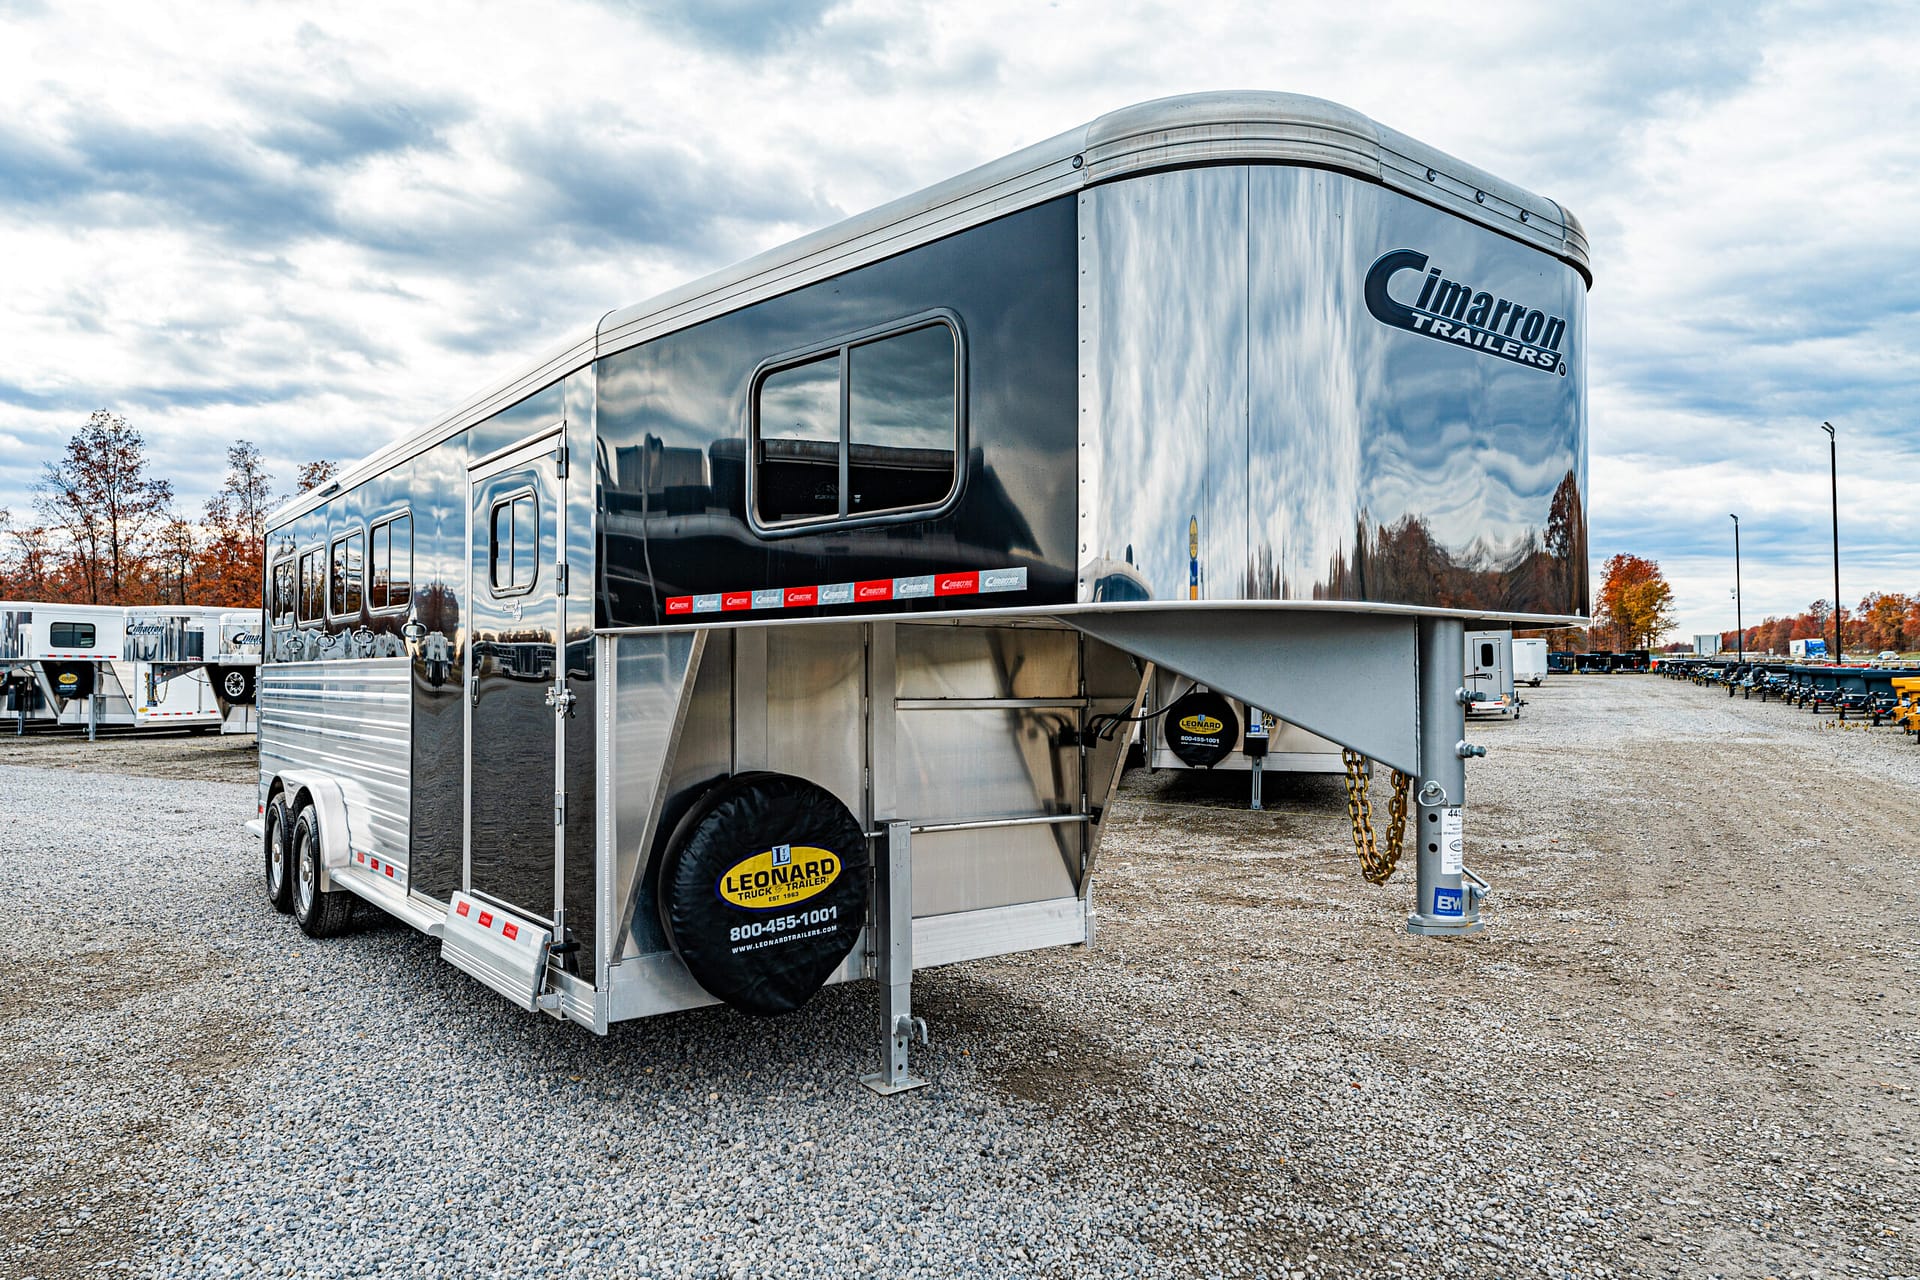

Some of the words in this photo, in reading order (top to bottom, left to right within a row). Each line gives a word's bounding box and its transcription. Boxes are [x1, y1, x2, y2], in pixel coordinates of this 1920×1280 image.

[1364, 249, 1566, 351] Cimarron
[1411, 312, 1556, 368] TRAILERS
[1180, 735, 1220, 744] 800-455-1001
[1181, 720, 1221, 729] LEONARD
[726, 858, 835, 893] LEONARD
[738, 887, 772, 901] TRUCK
[786, 876, 826, 891] TRAILER
[730, 906, 838, 941] 800-455-1001
[731, 925, 838, 954] WWW.LEONARDTRAILERS.COM
